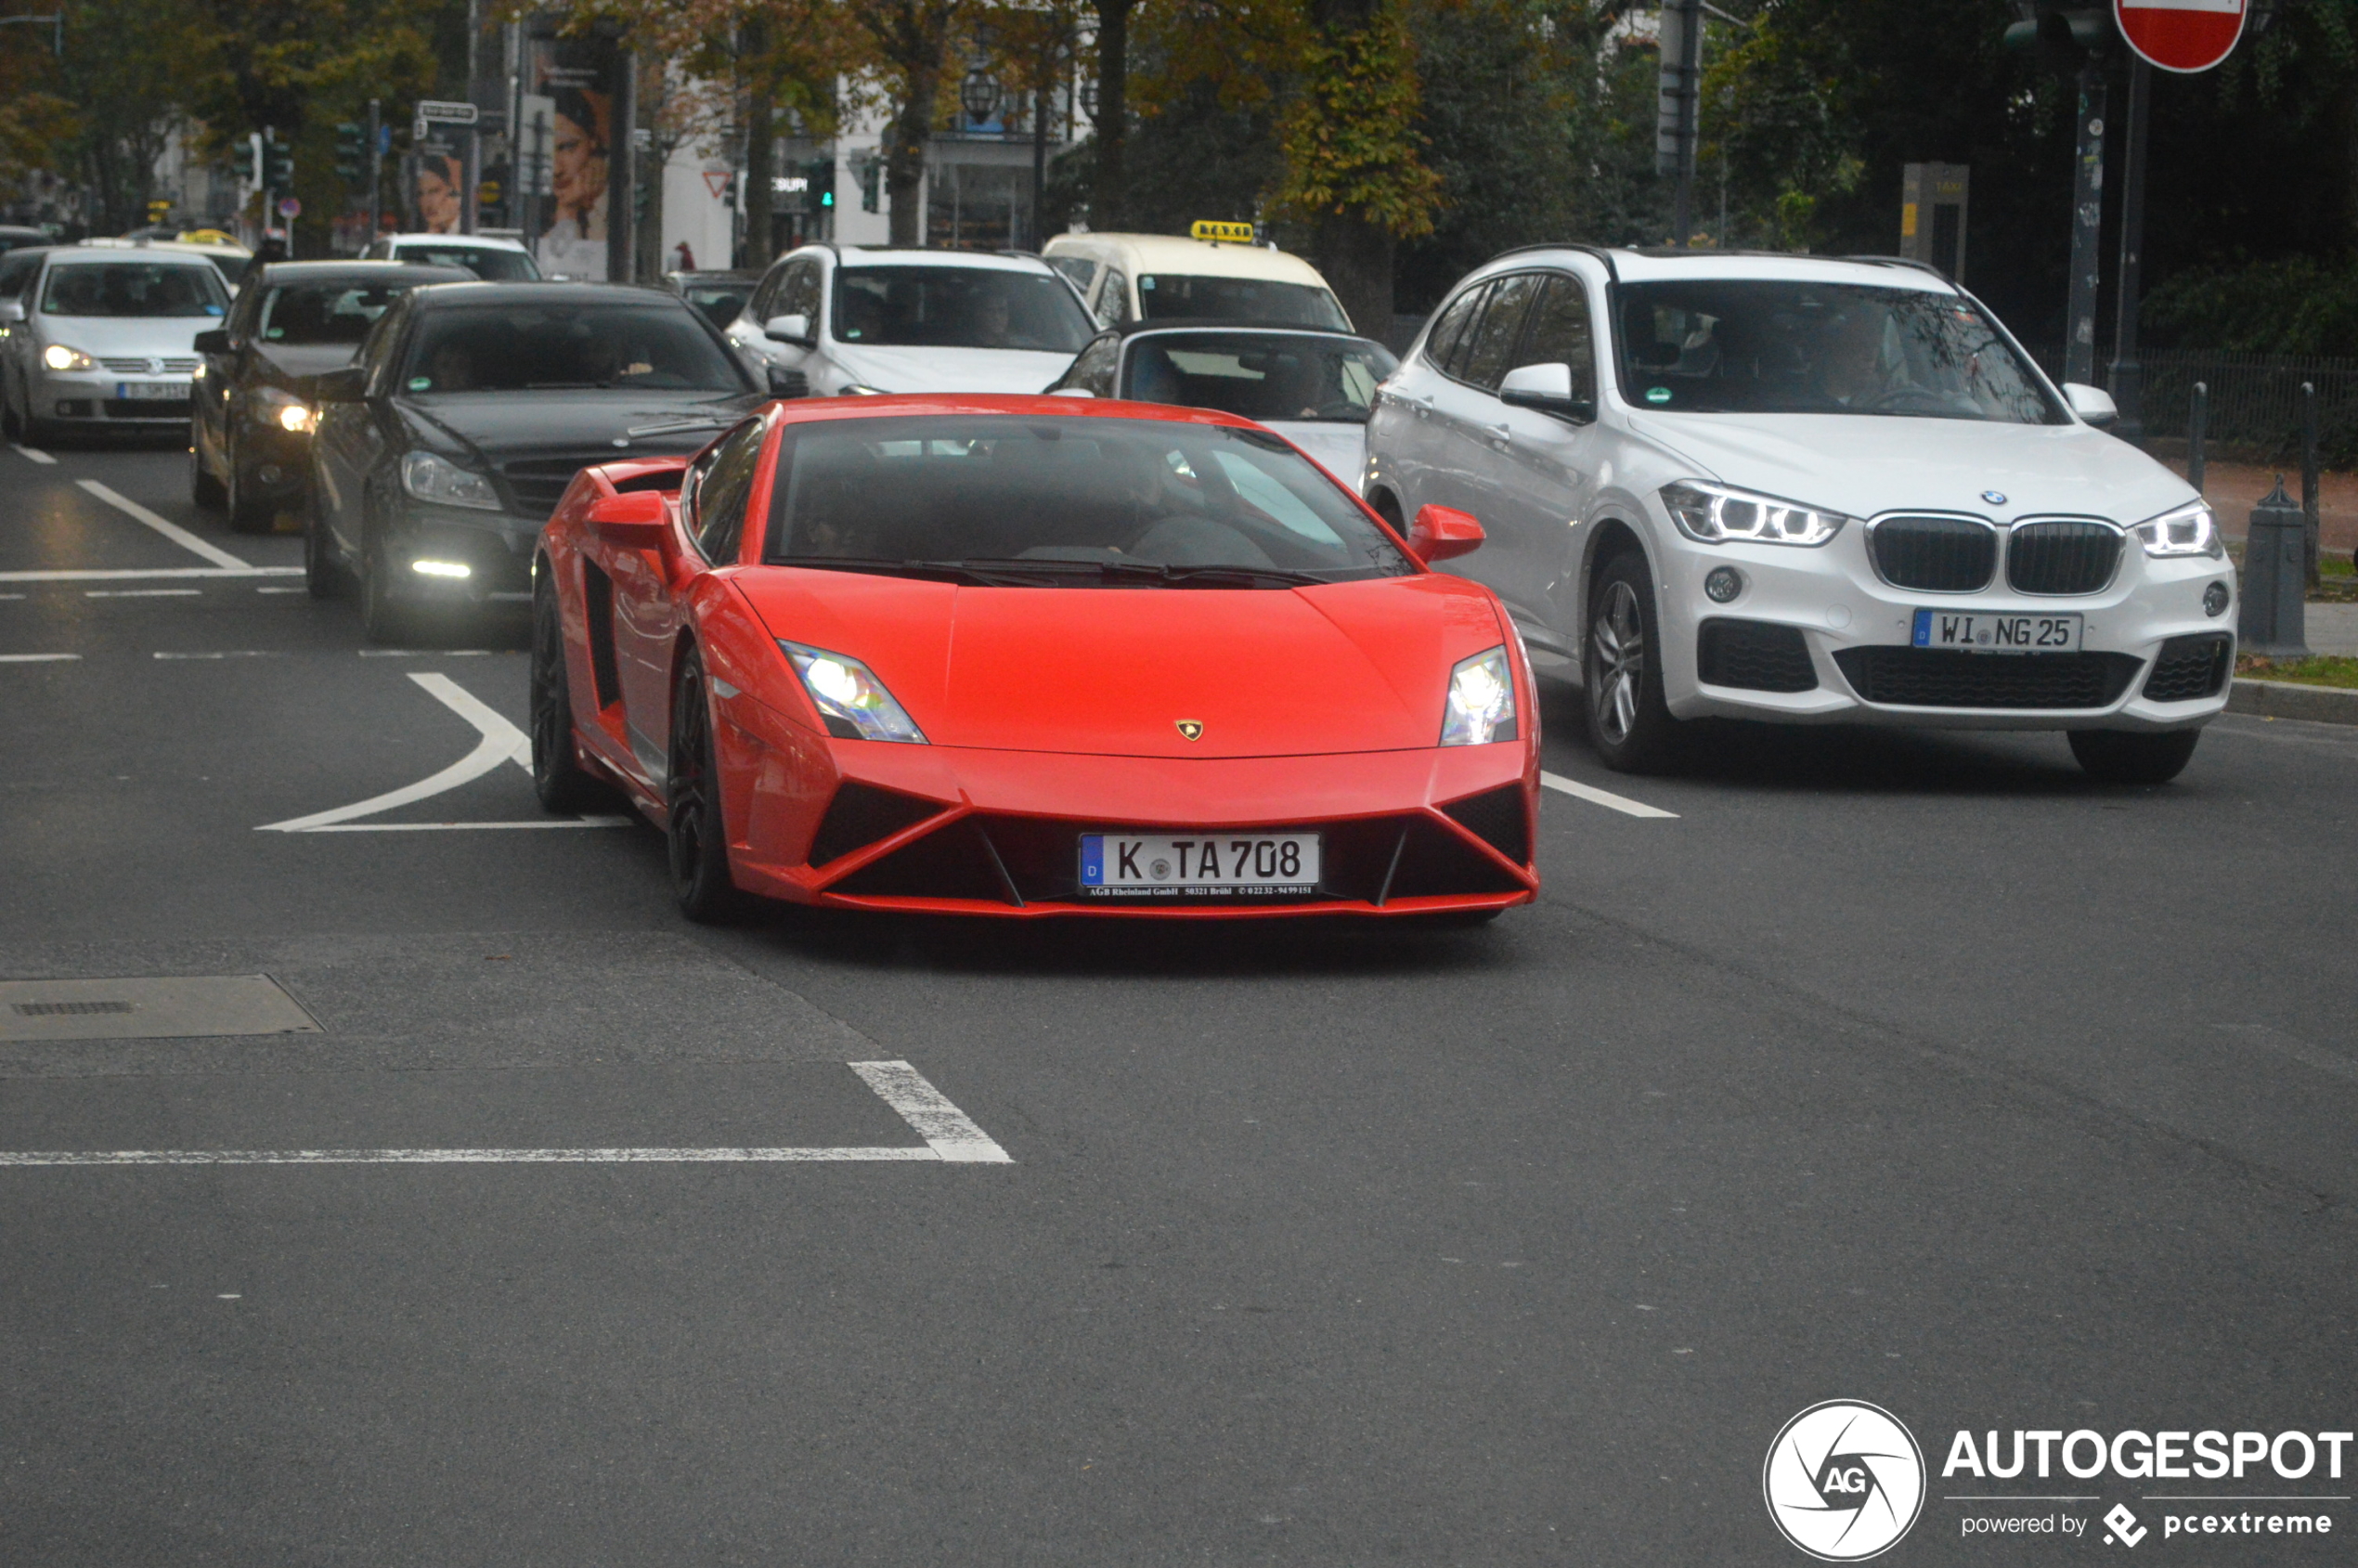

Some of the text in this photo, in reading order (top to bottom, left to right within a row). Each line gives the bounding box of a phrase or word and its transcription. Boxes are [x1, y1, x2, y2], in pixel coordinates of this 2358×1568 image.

[1201, 224, 1249, 236] TAXI
[1942, 616, 1975, 644] WI
[1995, 618, 2031, 645] NG
[2036, 619, 2070, 646] 25
[1088, 840, 1301, 879] D K TA 708
[1090, 888, 1110, 896] AGB
[1153, 888, 1178, 896] GmbH
[1210, 887, 1232, 895] Brühl
